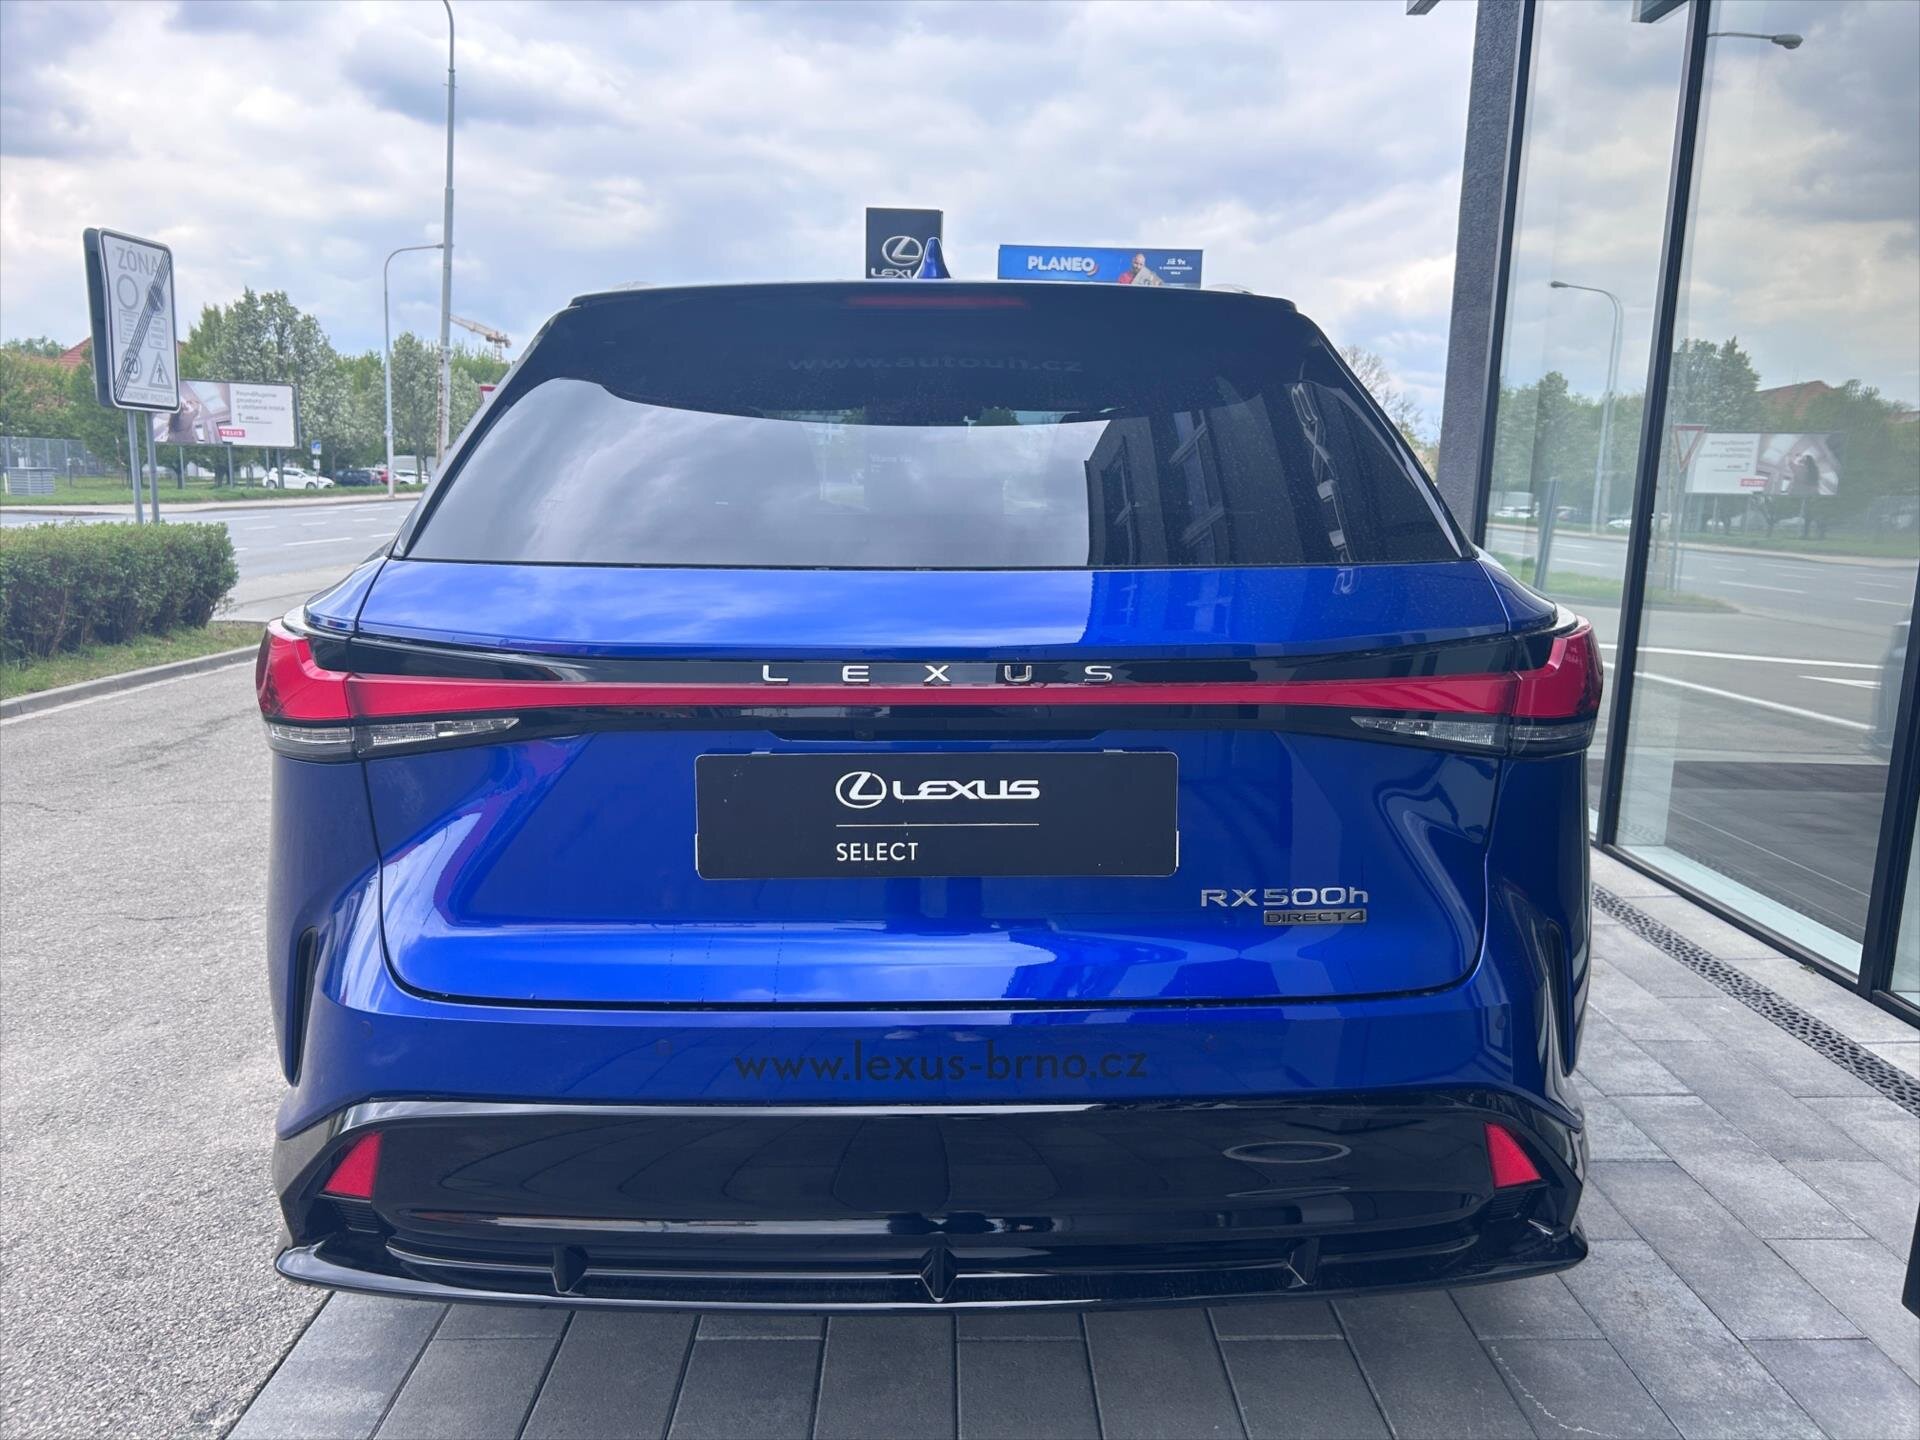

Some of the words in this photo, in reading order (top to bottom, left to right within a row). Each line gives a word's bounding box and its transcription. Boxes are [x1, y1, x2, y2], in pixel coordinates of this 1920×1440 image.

[870, 267, 913, 279] LEX
[1027, 255, 1098, 275] PLANEO
[762, 664, 1113, 682] LEXUS
[892, 779, 1041, 800] LEXUS
[836, 842, 919, 862] SELECT
[1266, 910, 1364, 924] DIRECT4
[734, 1040, 1148, 1081] www.lexus-brno.cz
